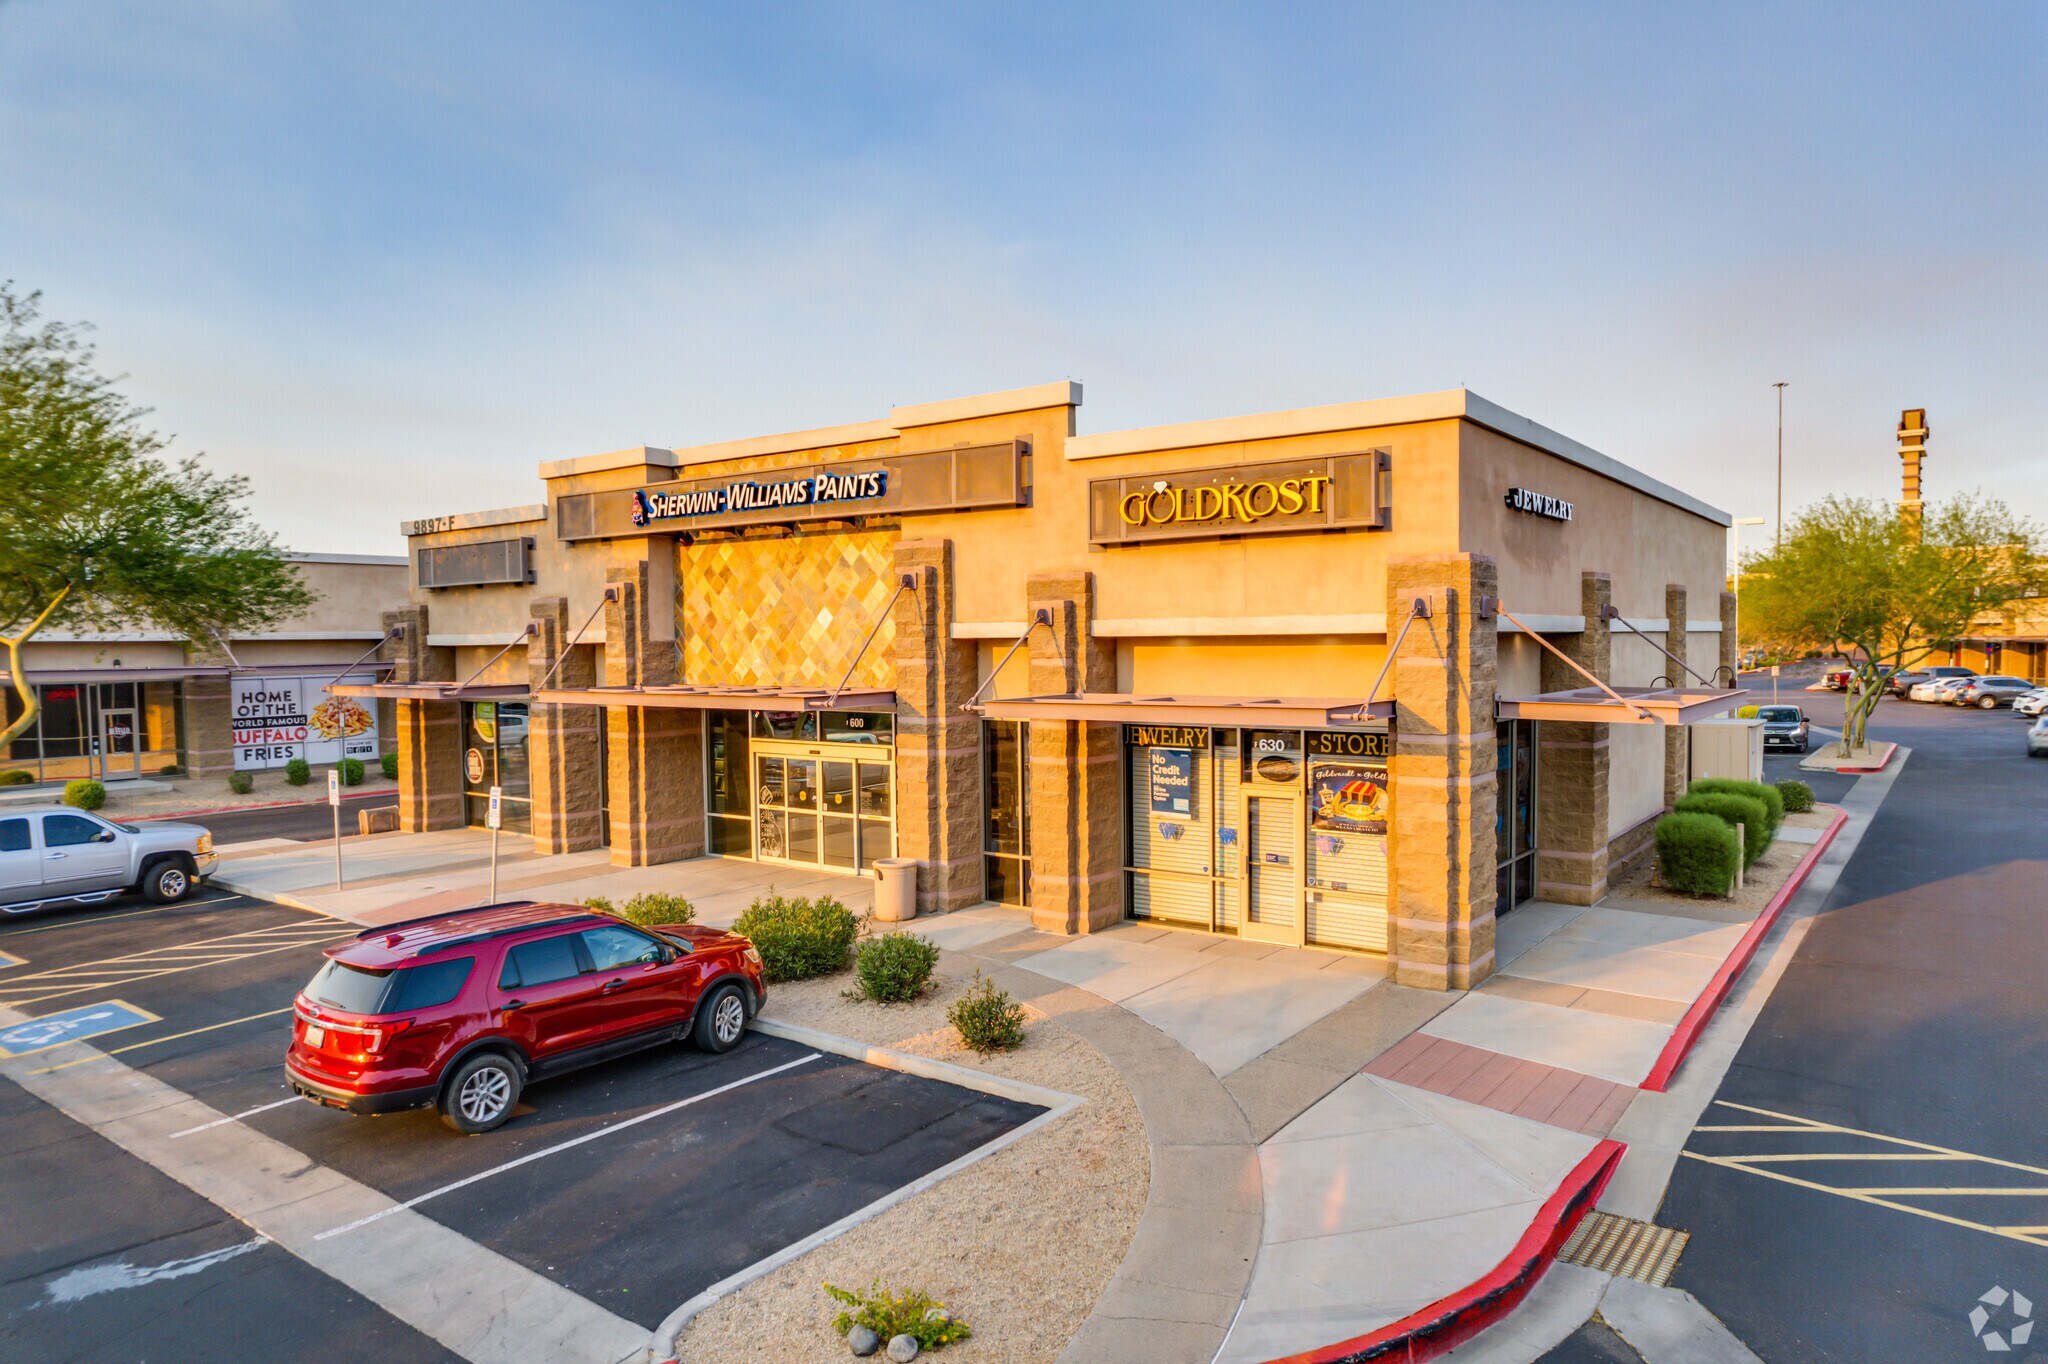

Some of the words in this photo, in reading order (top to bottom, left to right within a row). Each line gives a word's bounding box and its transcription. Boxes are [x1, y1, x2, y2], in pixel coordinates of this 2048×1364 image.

[647, 481, 808, 519] SHERWIN-WILLIAMS
[814, 472, 881, 502] PAINTS
[1119, 476, 1330, 527] GOLDKOST
[242, 691, 292, 703] HOME
[237, 704, 260, 717] OF
[265, 702, 297, 715] THE
[266, 716, 306, 726] FAMOUS
[850, 717, 864, 728] 600
[1260, 738, 1285, 752] 630
[244, 746, 294, 761] FRIES
[1152, 754, 1166, 765] No
[1152, 765, 1180, 775] Credit
[1153, 774, 1188, 787] Needed
